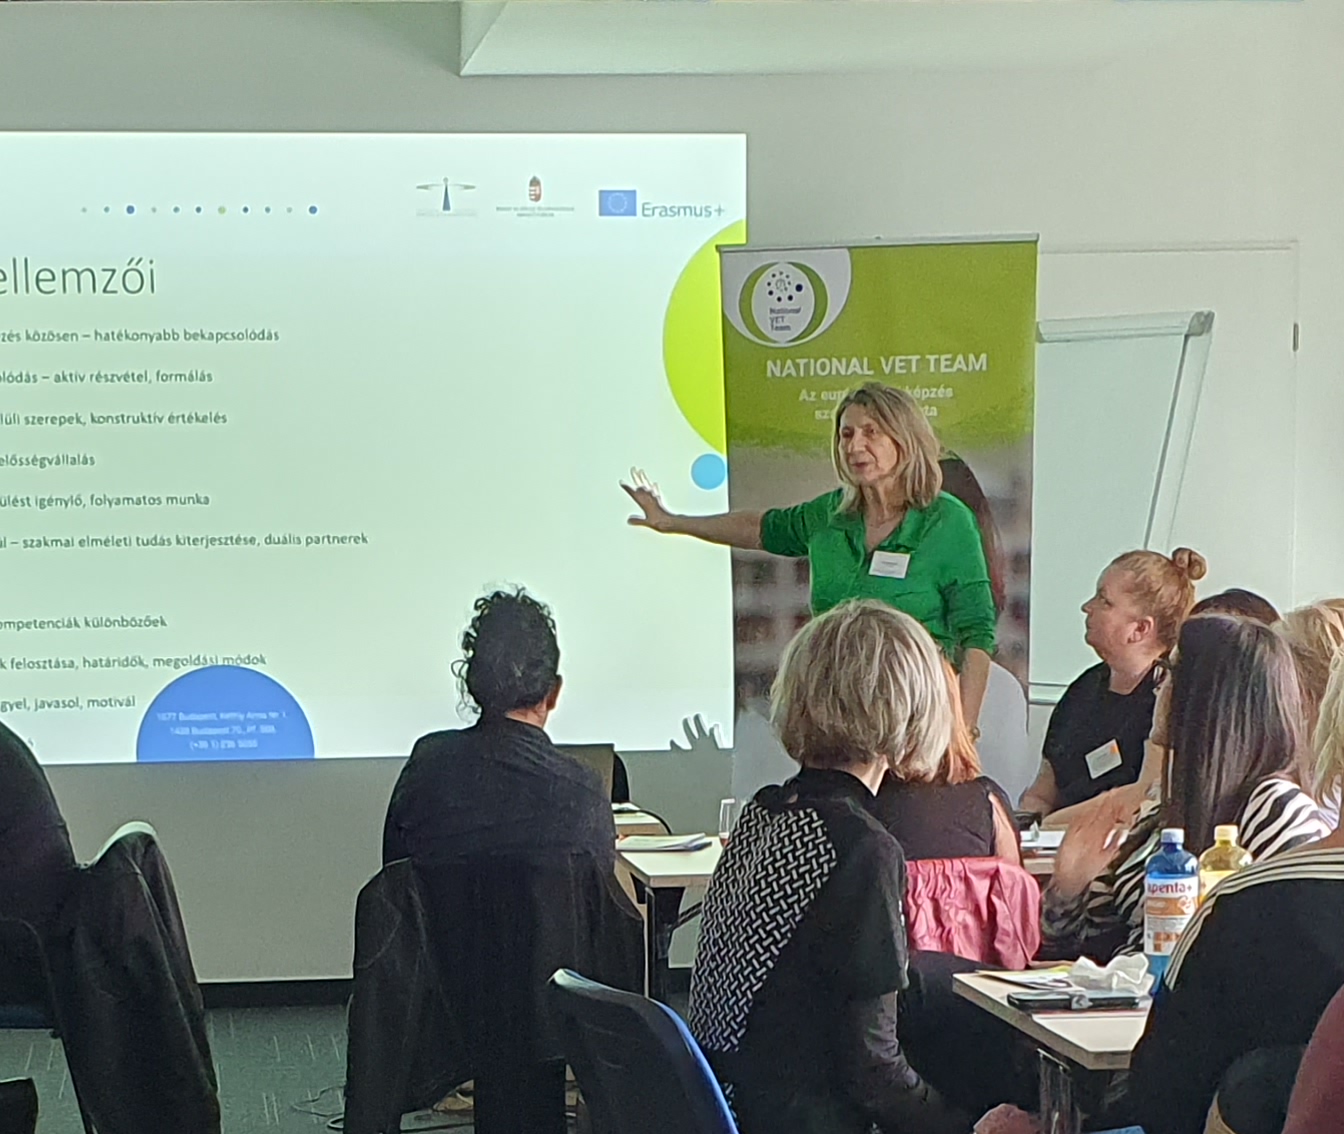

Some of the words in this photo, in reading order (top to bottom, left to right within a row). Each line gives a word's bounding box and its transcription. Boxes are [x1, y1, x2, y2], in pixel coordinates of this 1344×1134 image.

[642, 202, 724, 218] Erasmus+
[25, 329, 78, 342] közösen
[94, 328, 180, 343] hatékonyabb
[184, 328, 279, 344] bekapcsolódás
[766, 358, 874, 378] NATIONAL
[880, 355, 921, 374] VET
[925, 353, 987, 373] TEAM
[54, 371, 85, 383] aktív
[90, 370, 152, 384] részvétel,
[156, 370, 212, 382] formálás
[24, 413, 86, 427] szerepek,
[90, 412, 164, 424] konstruktív
[168, 412, 227, 424] értékelés
[90, 494, 162, 508] folyamatos
[166, 493, 209, 505] munka
[23, 536, 74, 548] szakmai
[78, 535, 132, 547] elméleti
[136, 534, 172, 546] tudás
[176, 534, 260, 549] kiterjesztése,
[264, 533, 301, 545] duális
[306, 532, 368, 547] partnerek
[11, 658, 78, 670] felosztása,
[83, 656, 148, 669] határidők,
[223, 654, 266, 667] módok
[34, 696, 83, 712] javasol,
[87, 695, 135, 708] motivál
